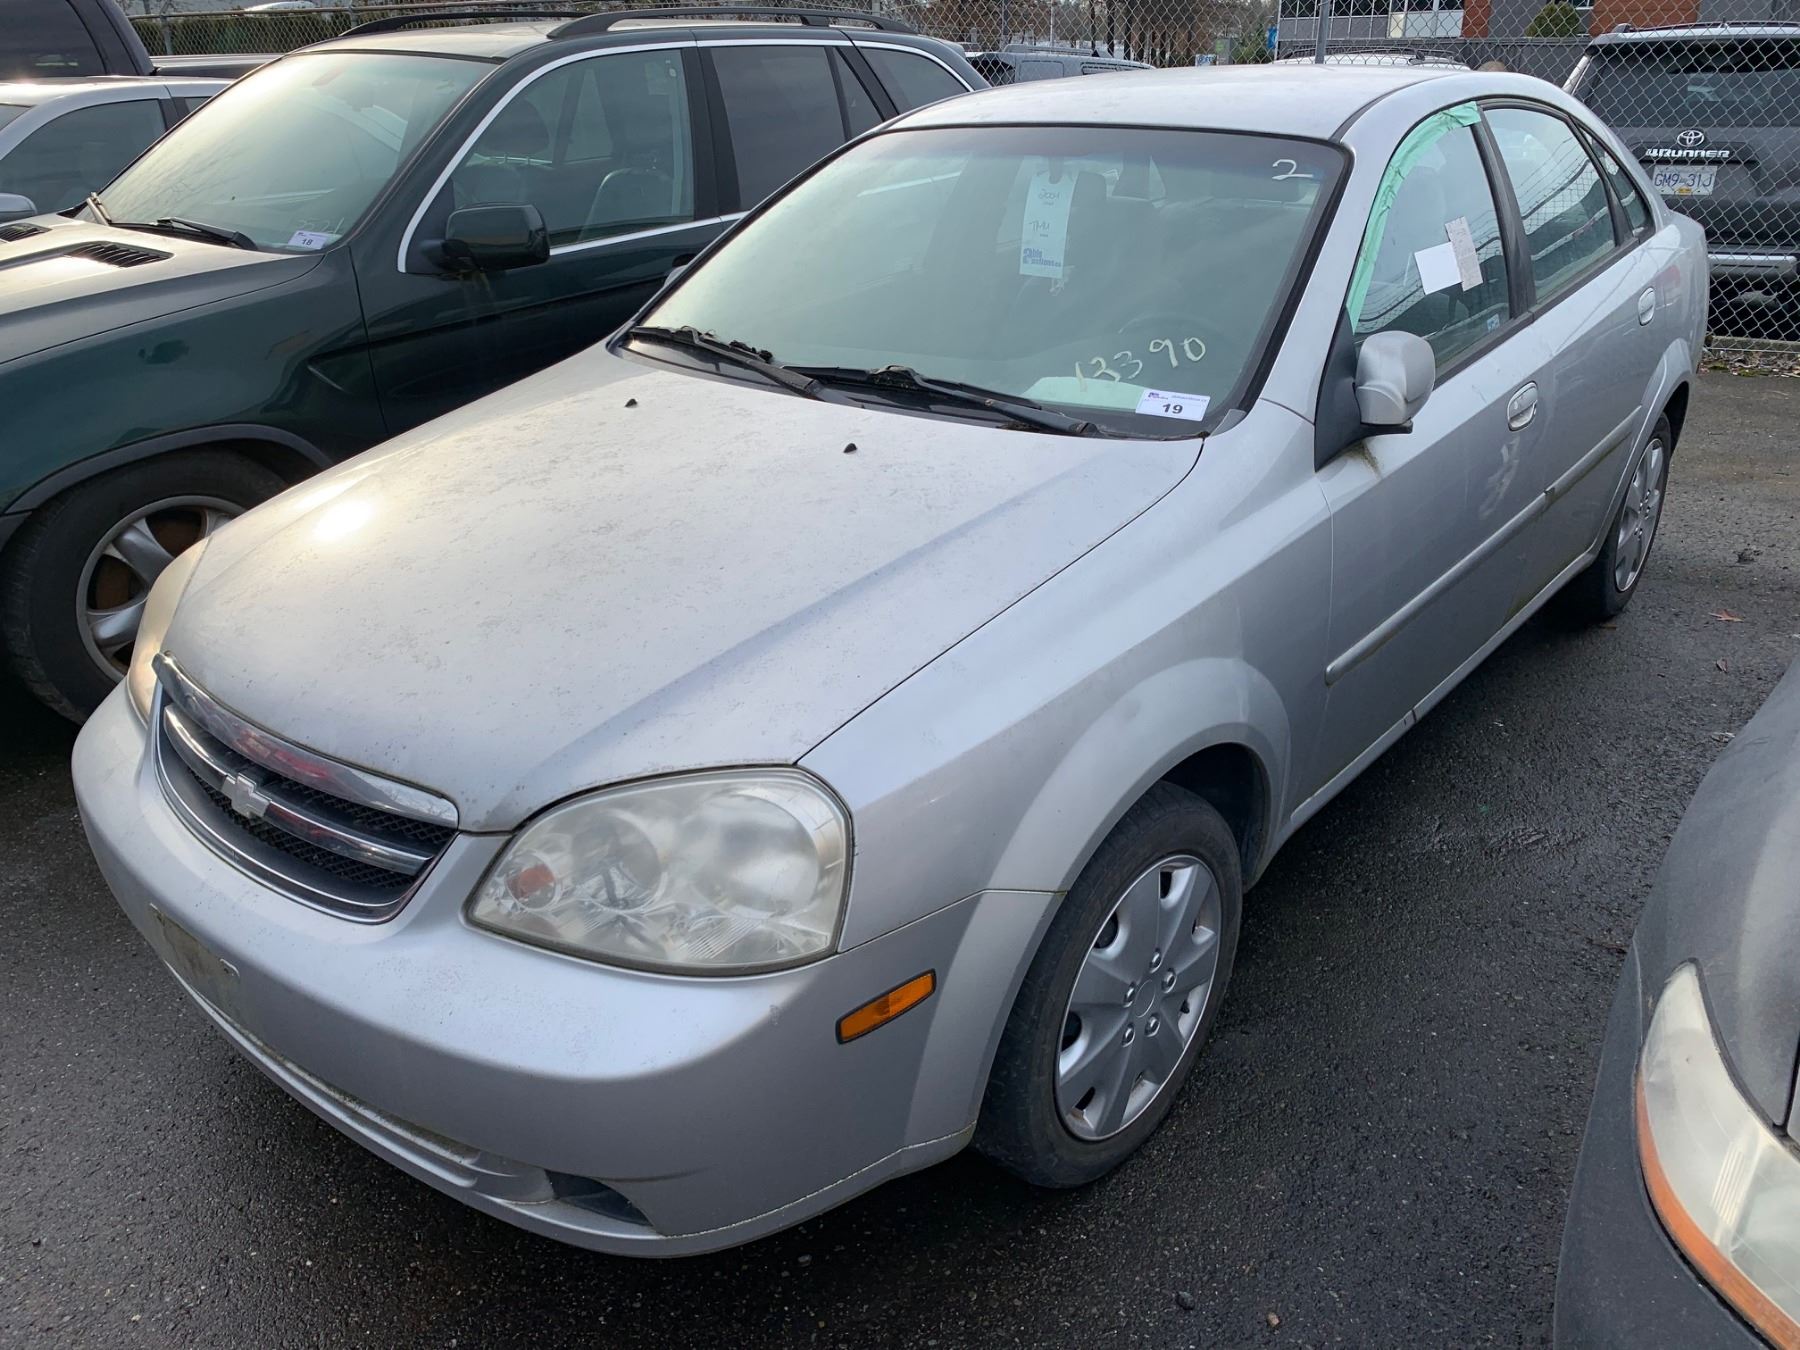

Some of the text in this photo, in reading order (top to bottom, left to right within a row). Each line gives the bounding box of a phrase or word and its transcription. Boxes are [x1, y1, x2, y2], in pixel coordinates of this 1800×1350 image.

[1645, 148, 1730, 158] 4RUNNER
[1272, 159, 1313, 180] 2
[302, 238, 314, 246] 18
[1162, 402, 1183, 415] 19
